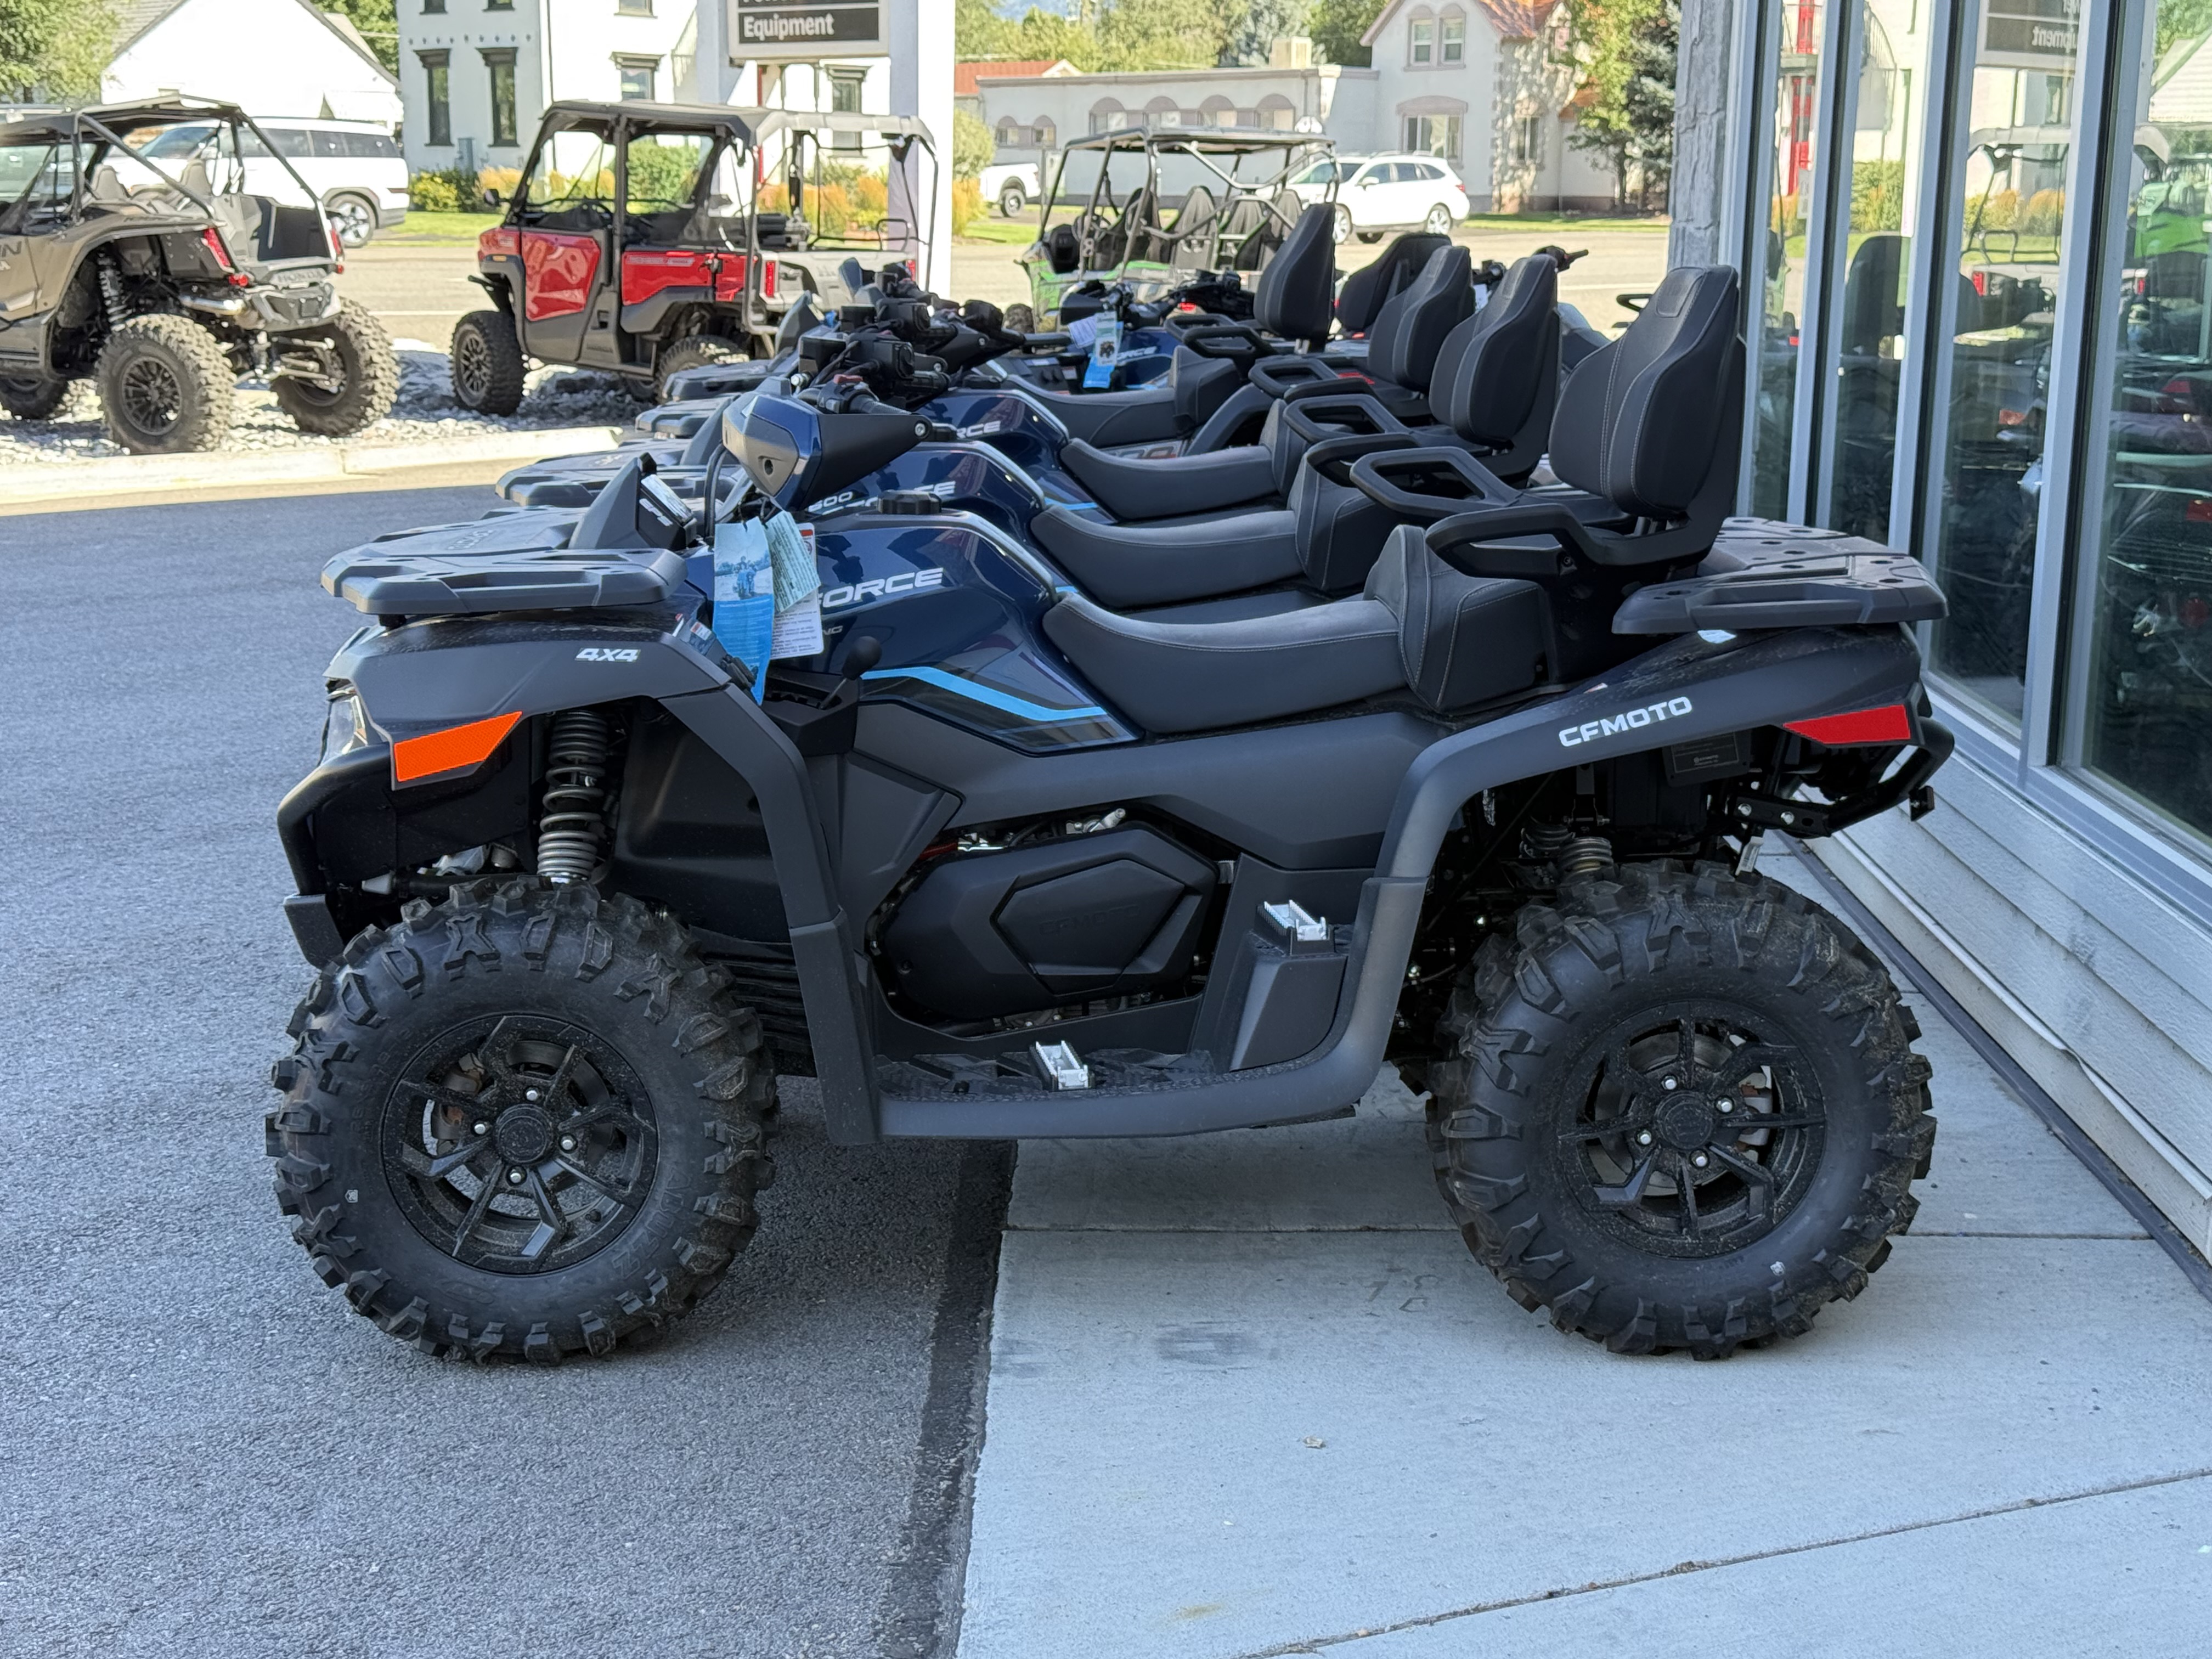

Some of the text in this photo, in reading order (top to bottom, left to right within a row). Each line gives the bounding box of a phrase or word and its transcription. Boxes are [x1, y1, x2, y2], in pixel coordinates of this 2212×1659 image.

[743, 13, 834, 41] Equipment
[808, 491, 853, 512] 600
[819, 567, 944, 608] ORCE
[1559, 696, 1692, 747] CFMOTO
